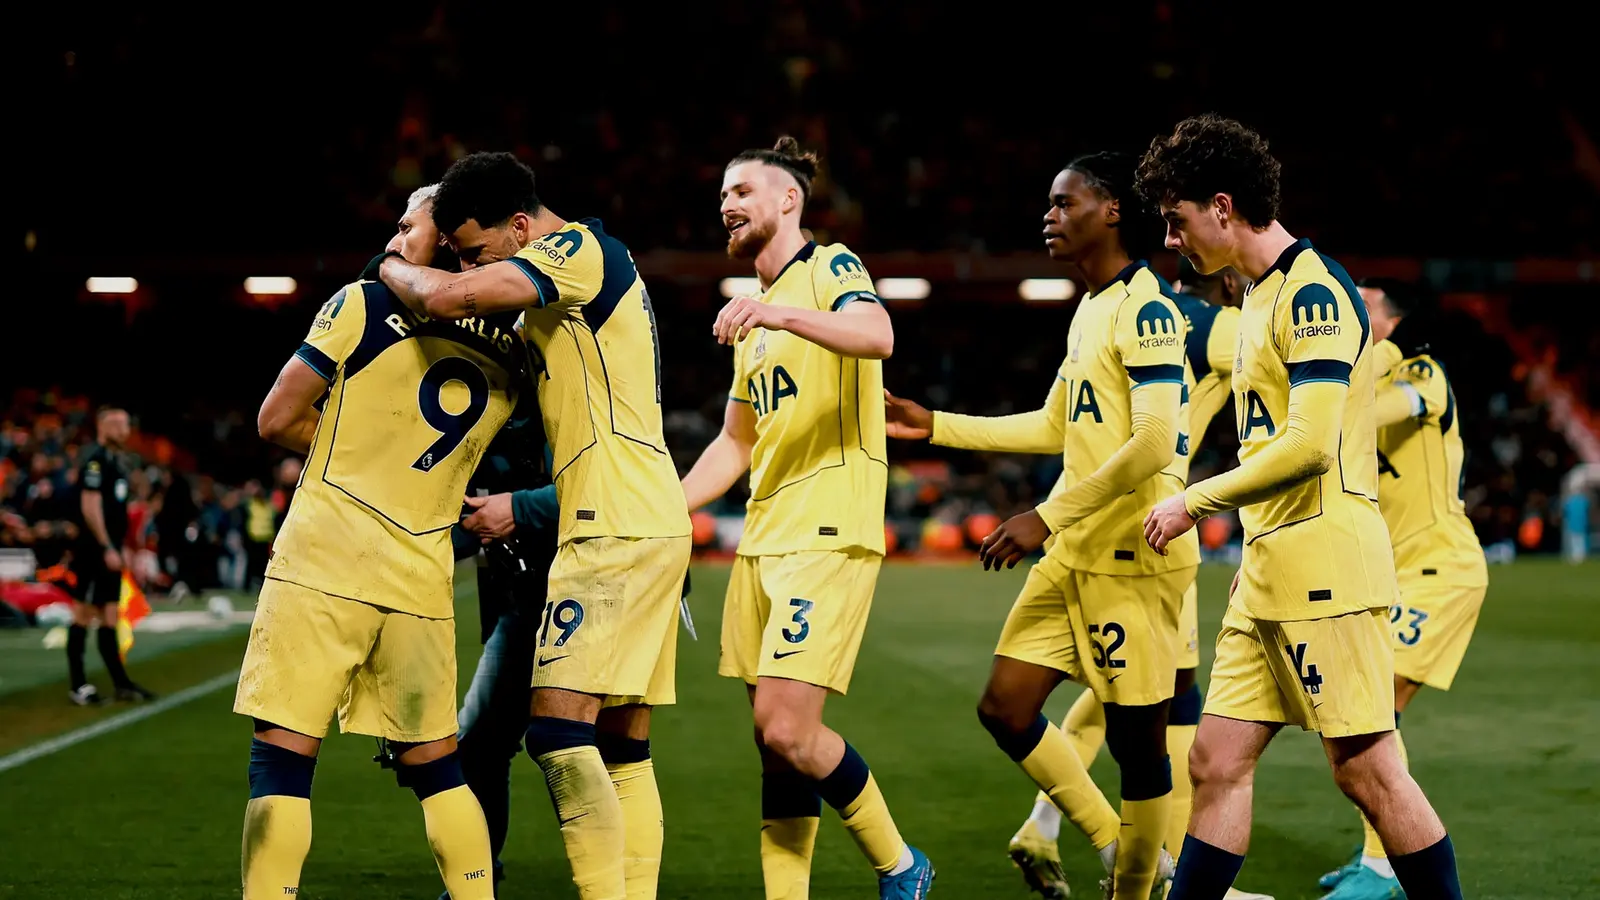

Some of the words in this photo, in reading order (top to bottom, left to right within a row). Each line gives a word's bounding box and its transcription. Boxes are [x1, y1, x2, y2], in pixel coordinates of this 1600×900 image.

[1293, 325, 1341, 340] kraken
[411, 356, 490, 472] 9
[748, 365, 798, 417] AIA
[1069, 379, 1104, 423] IA
[1240, 389, 1276, 441] IA
[539, 598, 584, 647] 19
[782, 597, 814, 644] 3
[1088, 621, 1126, 669] 52
[463, 869, 486, 881] THFC
